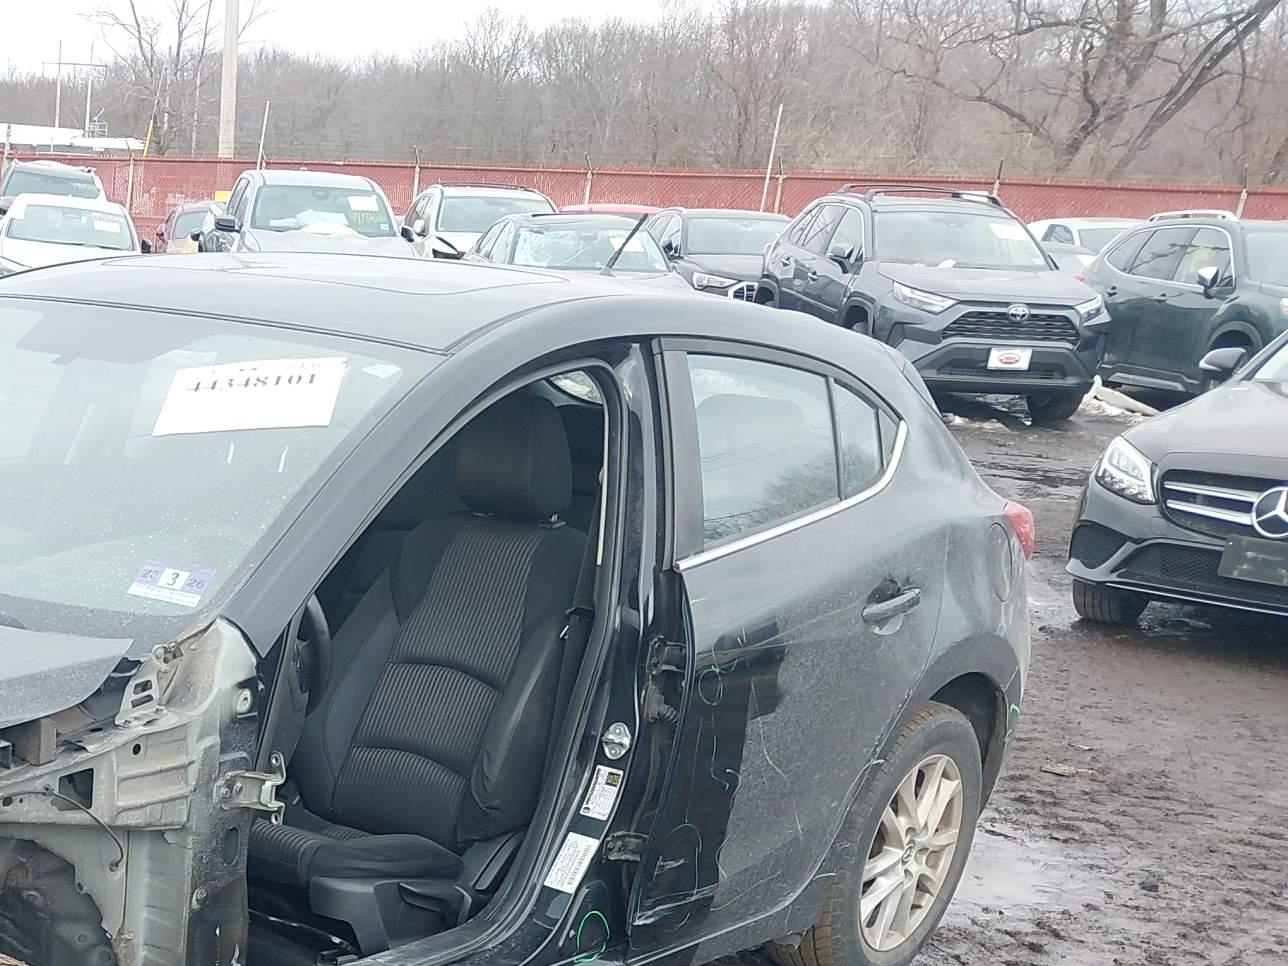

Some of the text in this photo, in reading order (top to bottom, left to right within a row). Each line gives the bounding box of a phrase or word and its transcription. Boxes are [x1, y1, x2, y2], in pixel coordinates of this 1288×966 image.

[142, 568, 206, 590] 20 3 26
